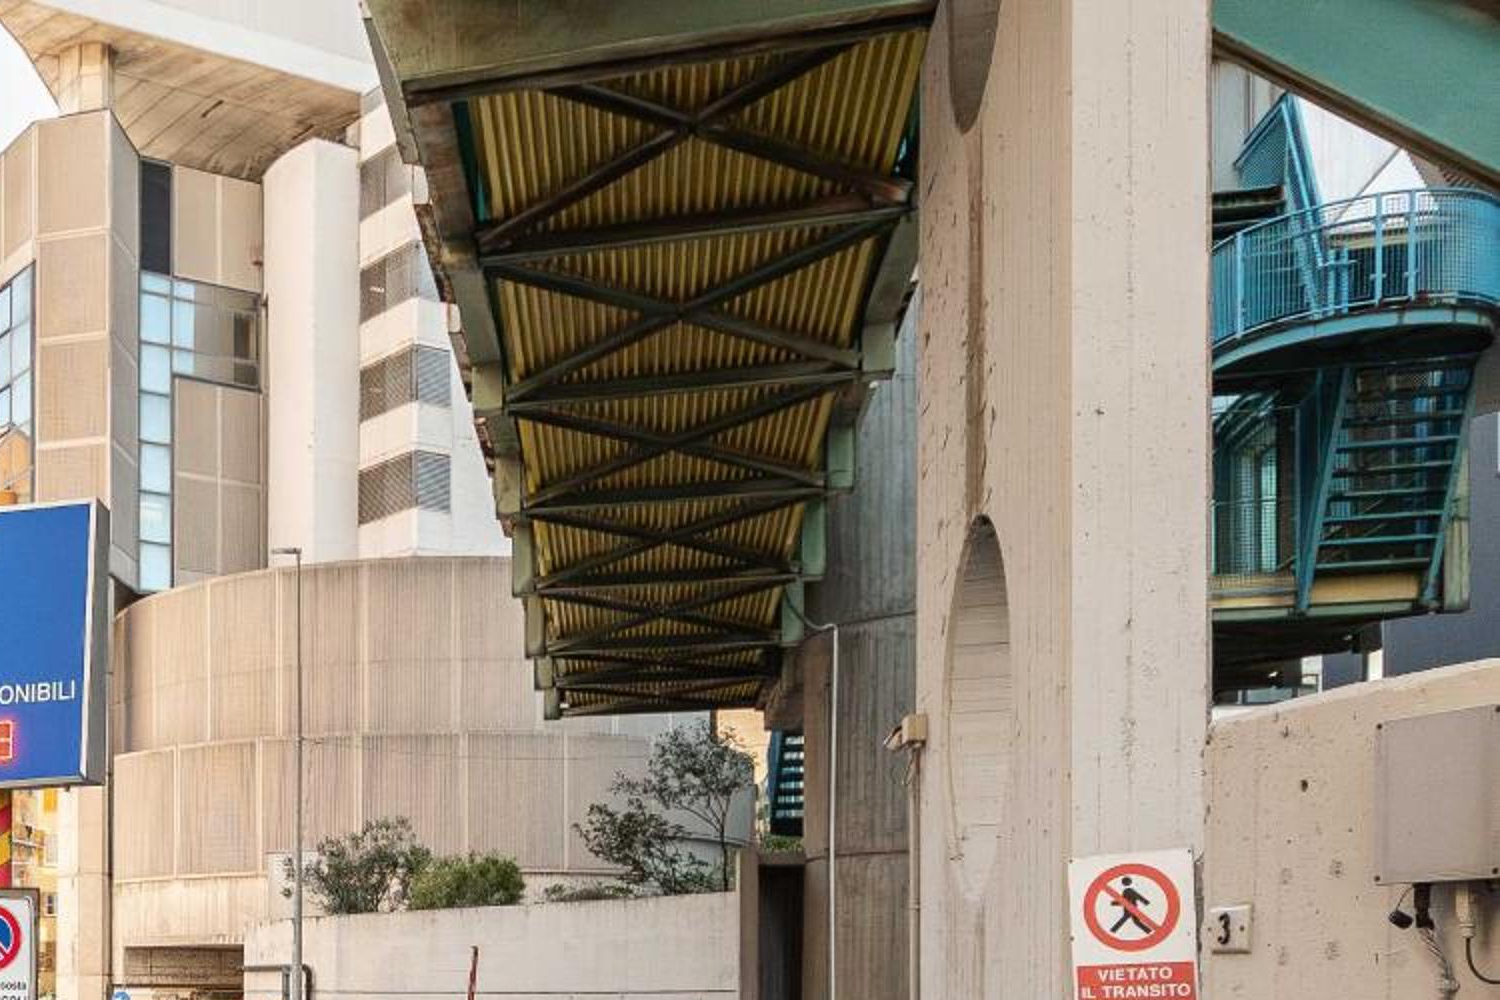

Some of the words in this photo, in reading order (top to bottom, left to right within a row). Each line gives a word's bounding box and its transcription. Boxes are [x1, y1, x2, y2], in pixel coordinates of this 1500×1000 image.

[1217, 912, 1231, 945] 3
[1098, 967, 1173, 982] VIETATO
[0, 981, 27, 990] sosta
[1081, 988, 1096, 999] IL
[1102, 983, 1191, 998] TRANSITO
